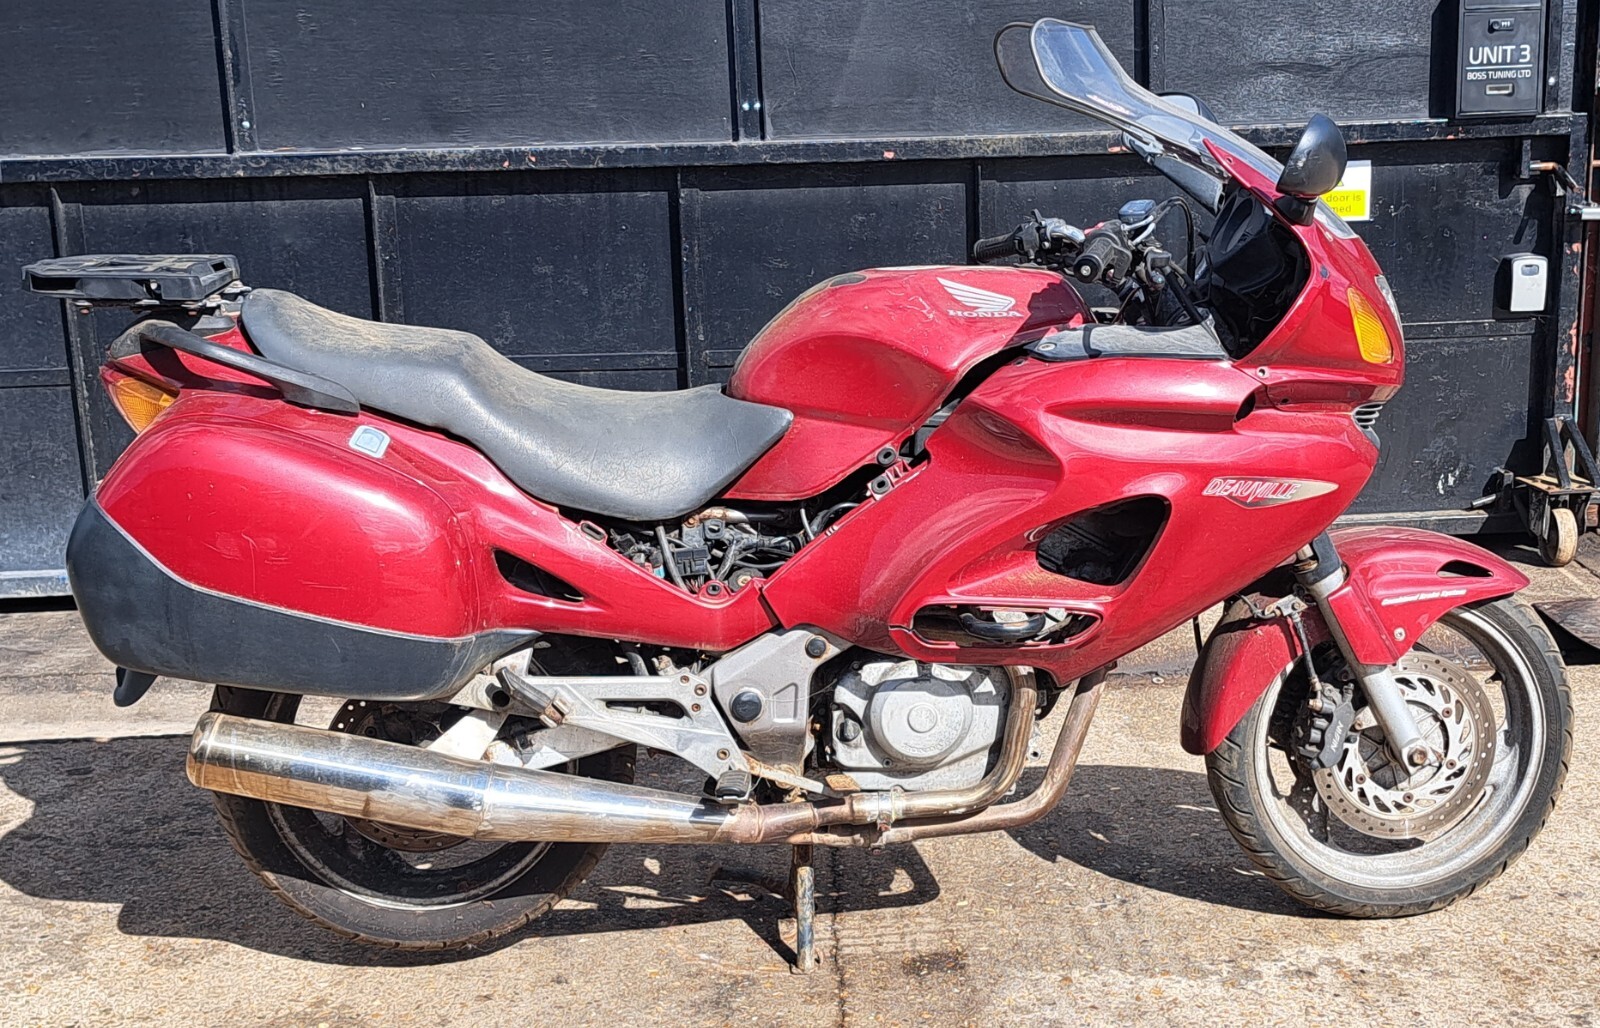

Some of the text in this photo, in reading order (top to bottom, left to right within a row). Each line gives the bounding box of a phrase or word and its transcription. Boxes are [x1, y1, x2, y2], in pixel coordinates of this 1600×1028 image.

[1469, 44, 1531, 64] UNIT 3
[1467, 69, 1531, 80] BOSS TUNING LTD
[1326, 193, 1362, 202] door is
[947, 309, 1024, 318] HONDA
[1201, 478, 1302, 503] DEAUVILLE
